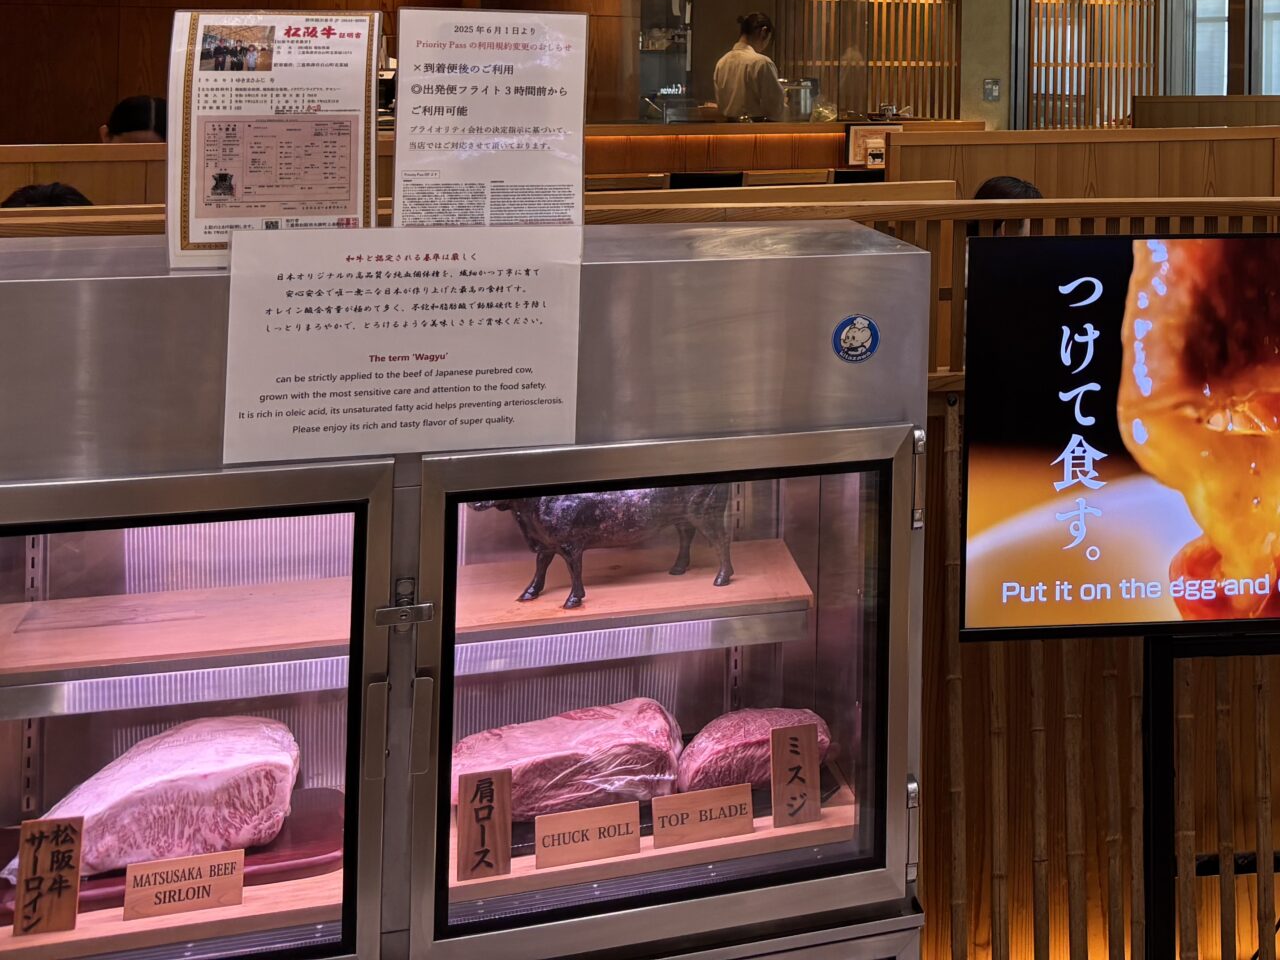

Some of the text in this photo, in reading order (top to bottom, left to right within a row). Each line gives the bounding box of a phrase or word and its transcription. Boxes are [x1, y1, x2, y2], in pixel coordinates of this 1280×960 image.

[284, 26, 337, 39] 松阪牛
[416, 40, 447, 49] Priority
[449, 41, 467, 49] Pass
[411, 105, 468, 117] ご利用可能
[294, 375, 306, 383] be
[308, 373, 337, 383] strictly
[340, 372, 372, 382] applied
[386, 371, 400, 379] the
[403, 370, 422, 378] beef
[435, 369, 473, 378] Japanese
[475, 367, 513, 377] purebred
[259, 394, 288, 403] grown
[290, 392, 310, 400] with
[312, 391, 326, 399] the
[329, 390, 351, 398] most
[353, 388, 391, 397] sensitive
[432, 385, 471, 393] attention
[484, 383, 498, 391] the
[500, 382, 519, 390] food
[521, 382, 547, 391] safety.
[247, 411, 254, 419] is
[256, 410, 272, 418] rich
[285, 408, 306, 417] oleic
[308, 408, 328, 416] acid,
[330, 407, 340, 415] its
[343, 404, 393, 414] unsaturated
[395, 403, 414, 412] fatty
[416, 402, 433, 410] acid
[435, 401, 457, 411] helps
[459, 399, 502, 409] preventing
[1050, 275, 1108, 561] つけて食す。
[292, 416, 515, 434] Please enjoy its rich and tasty flavor of super quality.
[1002, 582, 1047, 603] Put
[1055, 581, 1072, 601] it
[1080, 584, 1111, 600] on
[1119, 578, 1161, 598] the
[1170, 580, 1217, 601] egg
[1223, 574, 1269, 596] and
[785, 737, 809, 818] ミスジ
[470, 778, 495, 872] 肩ロース
[658, 803, 749, 829] TOP BLADE
[541, 822, 634, 848] CHUCK ROLL
[48, 823, 77, 899] 松阪牛
[21, 830, 50, 933] サーロイン
[132, 860, 237, 889] MATSUSAKA BEEF
[154, 884, 212, 906] SIRLOIN
